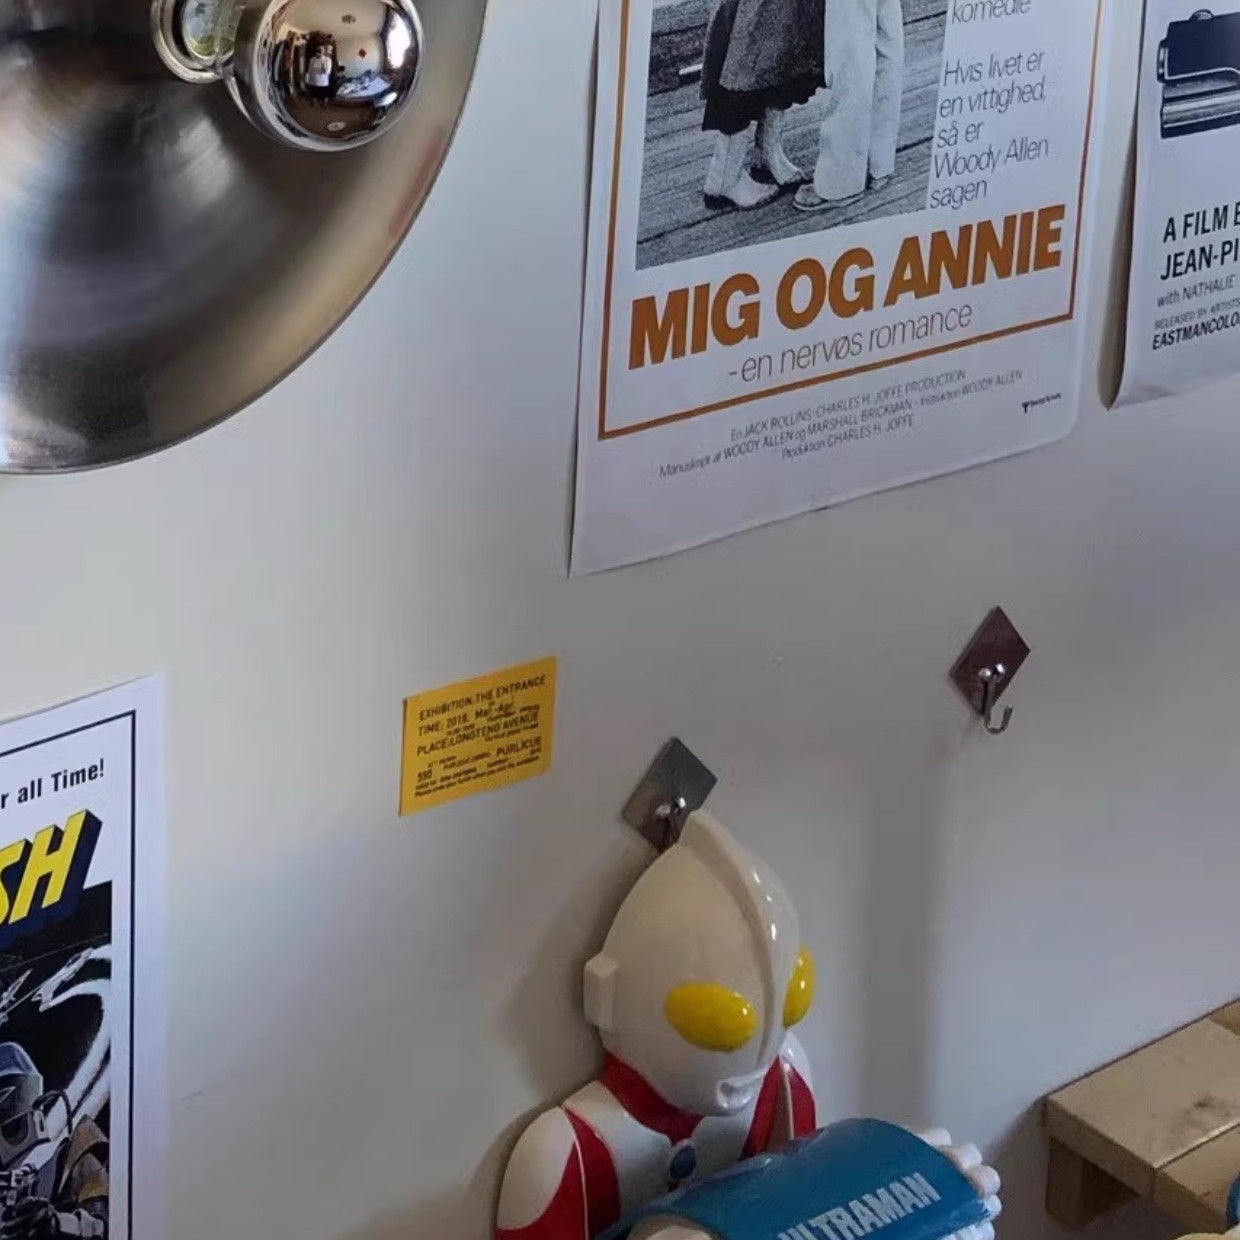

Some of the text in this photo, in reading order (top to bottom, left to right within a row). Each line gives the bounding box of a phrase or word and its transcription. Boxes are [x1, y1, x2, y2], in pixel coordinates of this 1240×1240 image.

[943, 51, 1044, 87] Hvis livet er
[939, 96, 963, 118] en
[938, 120, 983, 148] så er
[934, 136, 1049, 179] Woody Allen
[930, 179, 988, 210] sagen
[1163, 205, 1228, 243] A FILM
[627, 204, 1066, 370] MIG OG ANNIE
[1182, 274, 1236, 300] NATHALIE
[780, 331, 863, 375] nervøs
[869, 302, 973, 352] romance
[17, 777, 42, 804] all
[51, 758, 104, 793] Time!
[777, 1171, 942, 1240] ULTRAMAN
